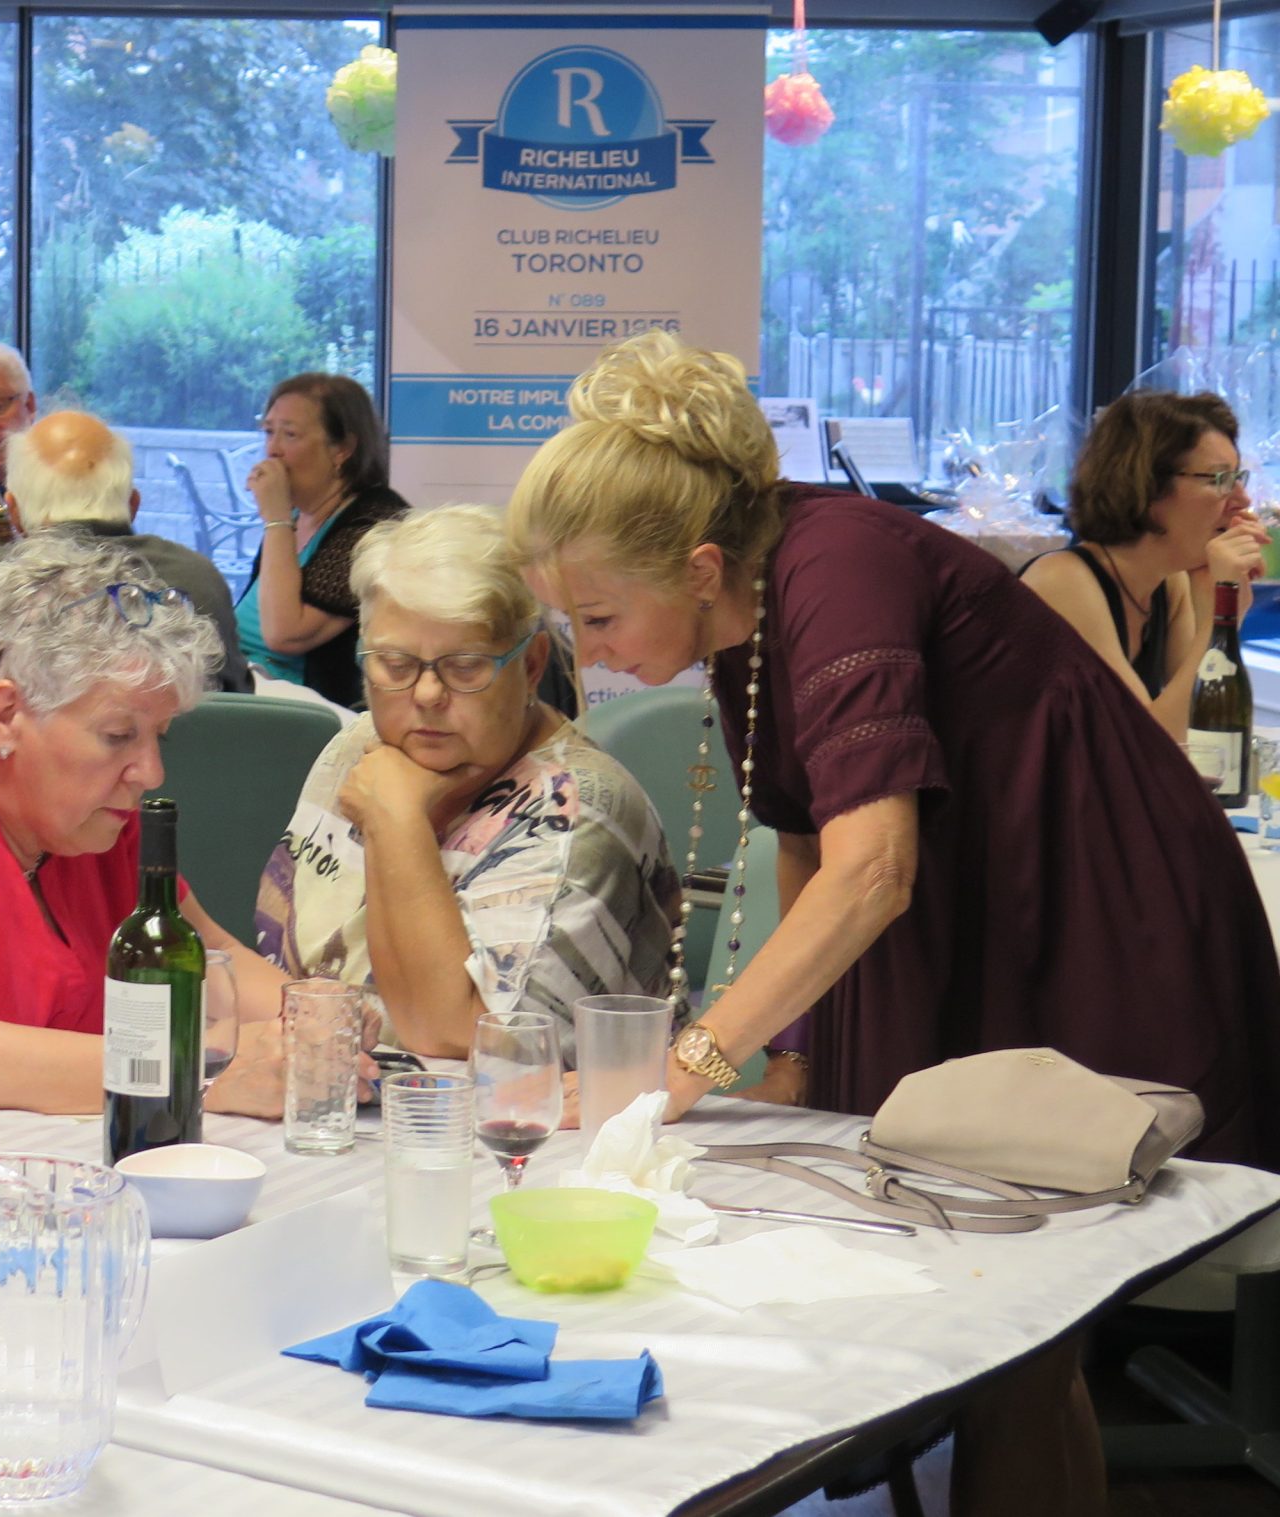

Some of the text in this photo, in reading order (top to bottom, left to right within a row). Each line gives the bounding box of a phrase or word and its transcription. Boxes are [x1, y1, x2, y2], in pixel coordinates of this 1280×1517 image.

[552, 67, 612, 137] R
[519, 148, 640, 169] RICHELIEU
[500, 169, 657, 191] INTERNATIONAL
[496, 228, 659, 245] CLUB RICHELIEU
[511, 253, 644, 273] TORONTO
[474, 318, 500, 337] 16
[506, 318, 616, 337] JANVIER
[448, 388, 515, 405] NOTRE
[488, 414, 515, 430] LA
